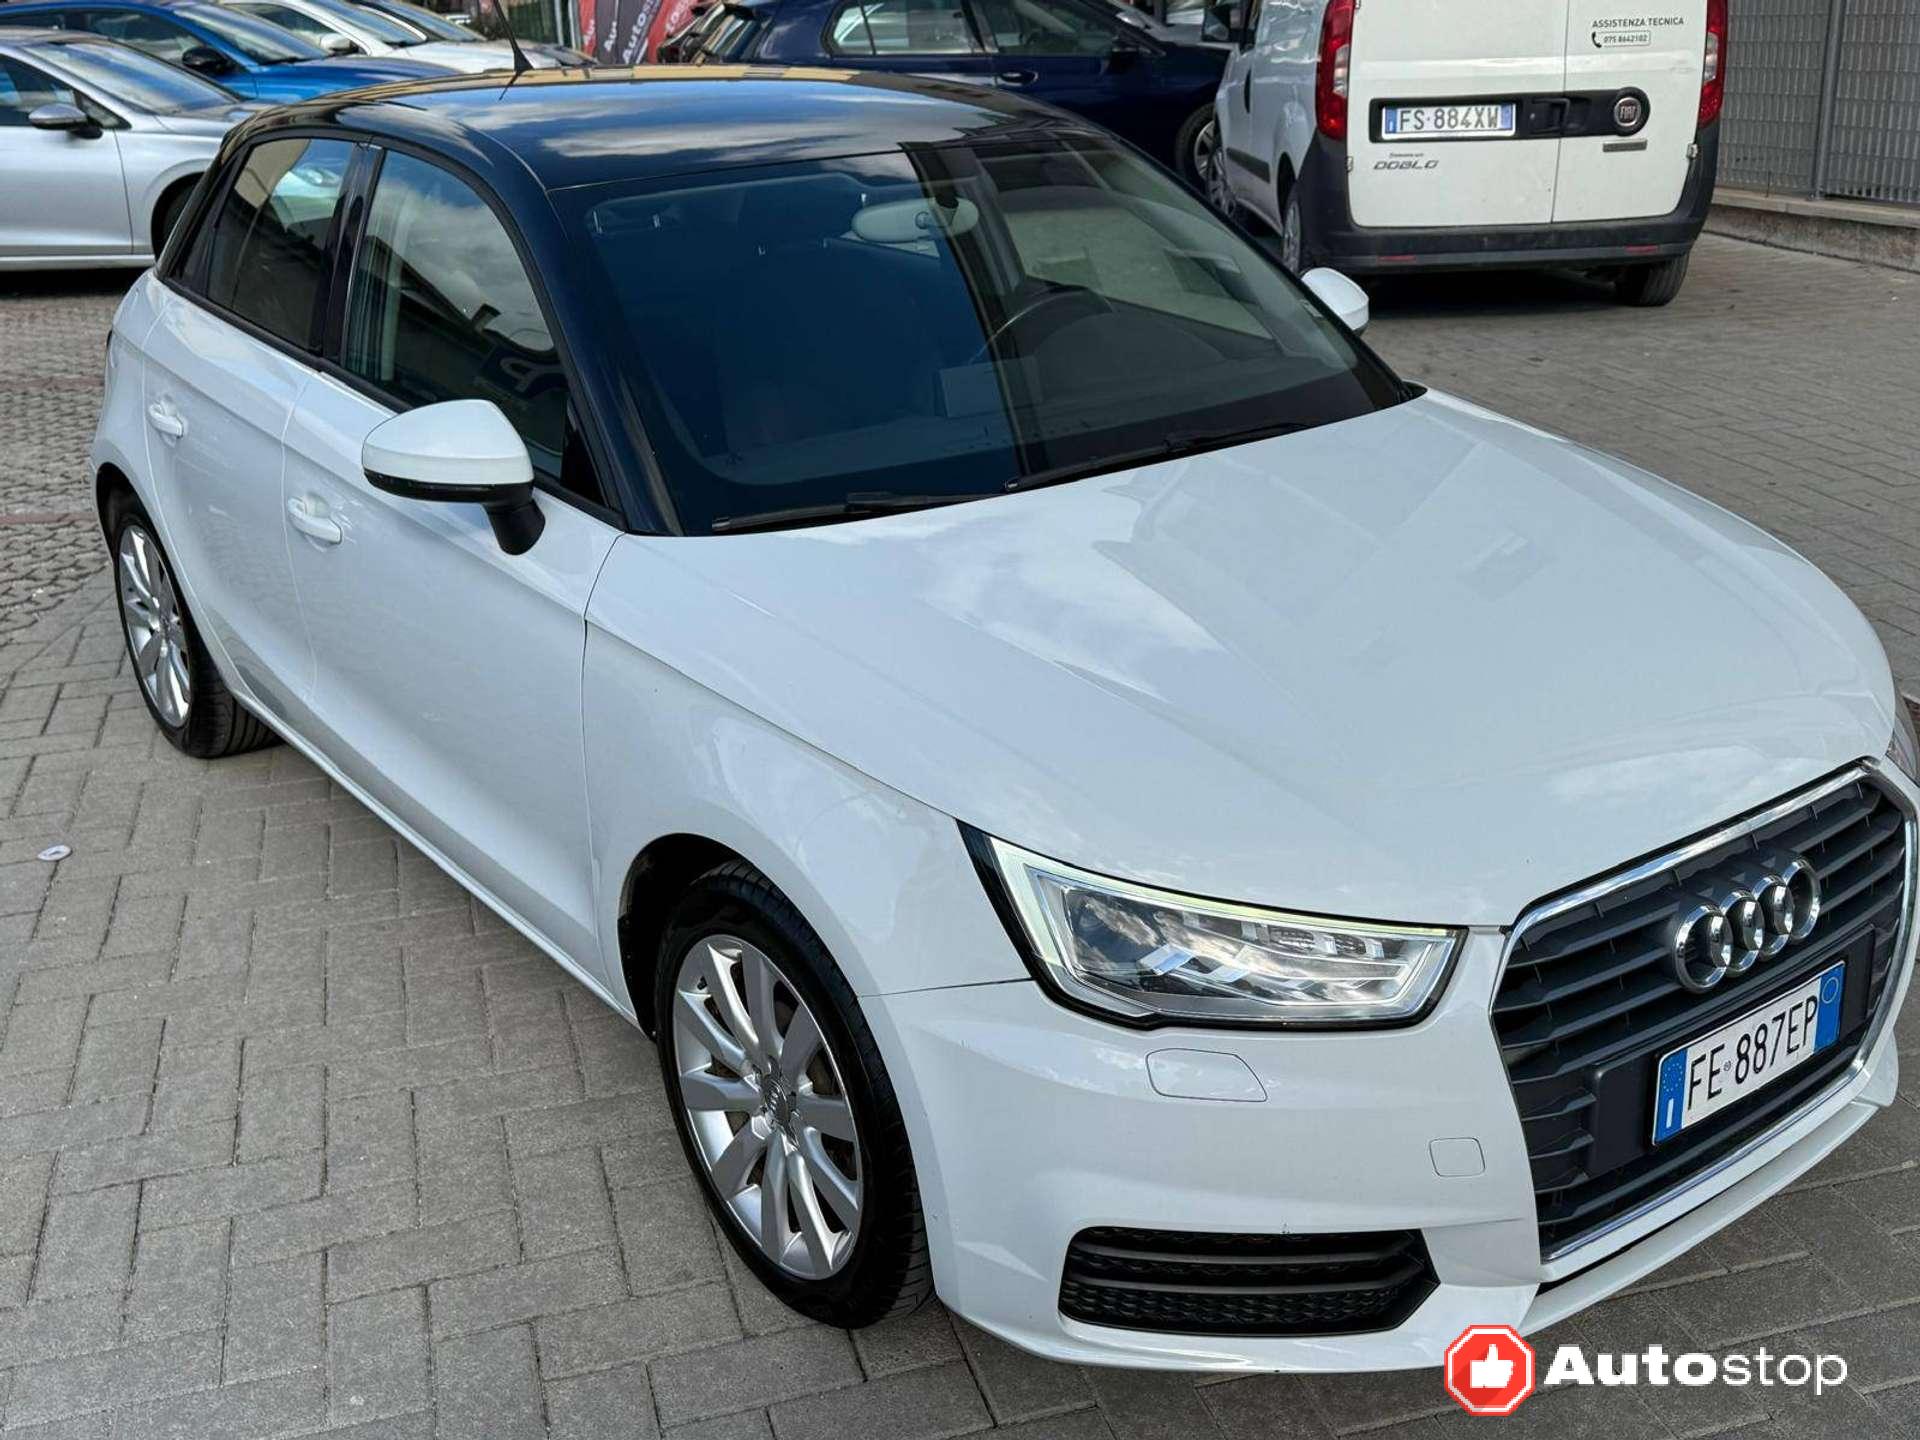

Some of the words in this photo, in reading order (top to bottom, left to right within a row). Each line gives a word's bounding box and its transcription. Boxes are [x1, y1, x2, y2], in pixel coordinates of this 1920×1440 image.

[1592, 18, 1645, 28] ASSISTENZA
[1648, 16, 1684, 26] TECNICA
[1603, 35, 1616, 44] 075
[1400, 109, 1425, 131] FS
[1434, 106, 1499, 130] 884XW
[1620, 105, 1636, 120] FIAT
[1688, 1044, 1724, 1110] FE
[1734, 995, 1818, 1085] 887EP
